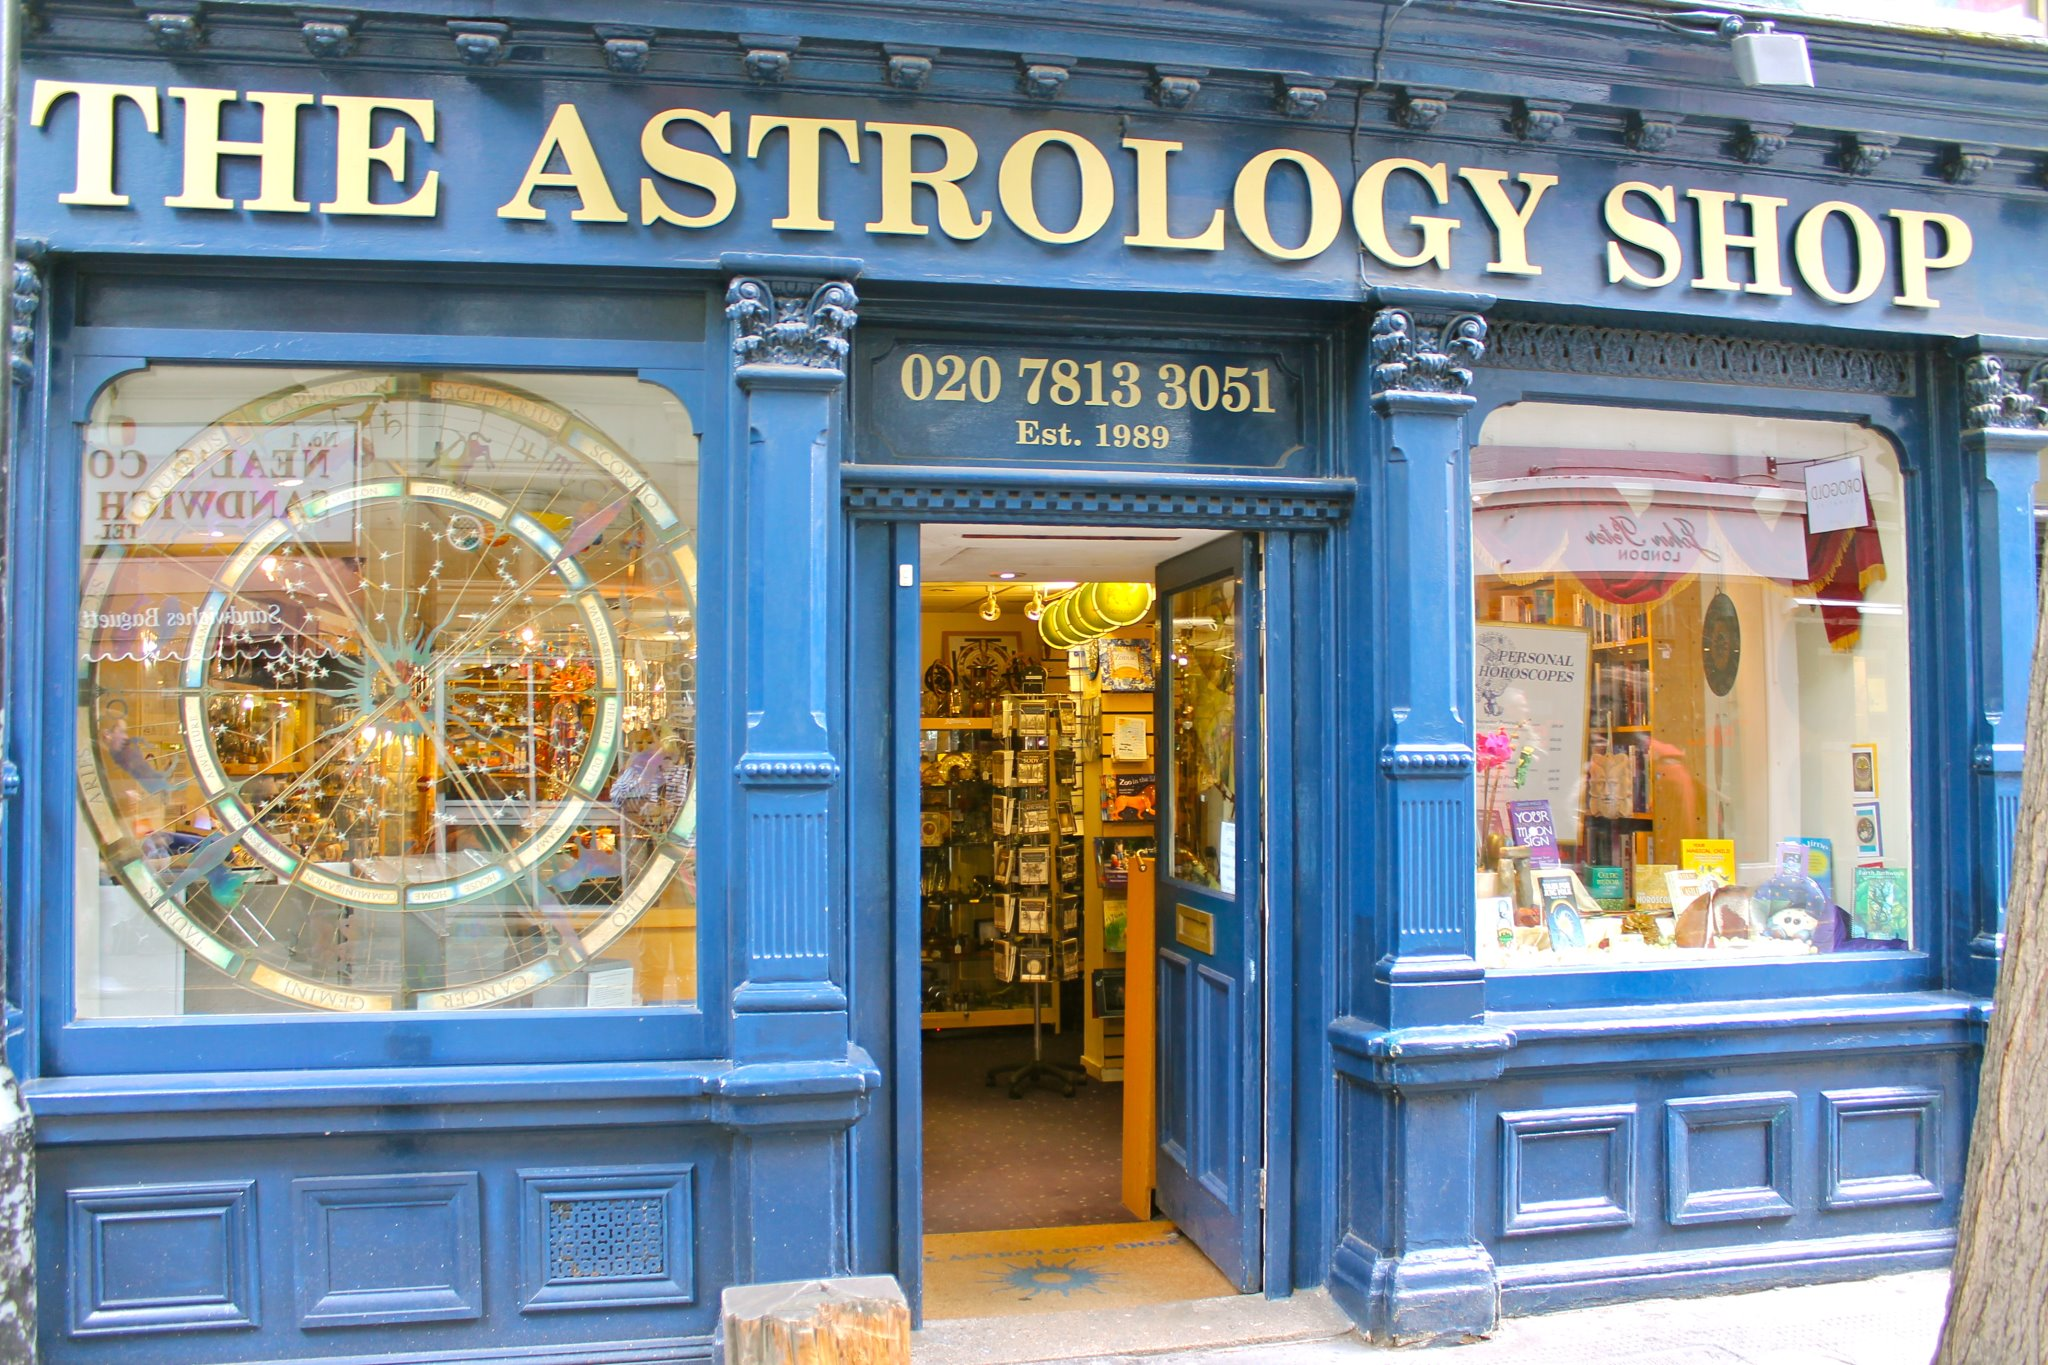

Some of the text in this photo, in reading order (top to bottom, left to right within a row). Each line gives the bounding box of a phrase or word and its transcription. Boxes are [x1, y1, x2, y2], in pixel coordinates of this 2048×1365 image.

[30, 79, 1974, 308] THE ASTROLOGY SHOP
[901, 353, 1276, 413] 020 7813 3051
[432, 382, 562, 430] SAGITTARIUS
[1015, 420, 1170, 449] Est. 1989
[426, 485, 490, 509] PHILOSOPHY
[552, 549, 578, 581] DATH
[588, 605, 614, 678] PARTNERSHIPS
[1479, 665, 1575, 682] HOROSCOPES
[1499, 650, 1575, 666] PERSONAL
[600, 703, 617, 745] HEALTH
[1514, 810, 1550, 823] YOUR
[1524, 836, 1550, 847] SIGN
[304, 870, 397, 901] COMMUNICATION
[414, 889, 448, 900] HOME
[464, 872, 496, 895] HOUSE
[146, 887, 208, 949] TAURS
[612, 892, 646, 928] LEO
[284, 979, 366, 1011] GEMINI
[440, 974, 528, 1009] CANCER
